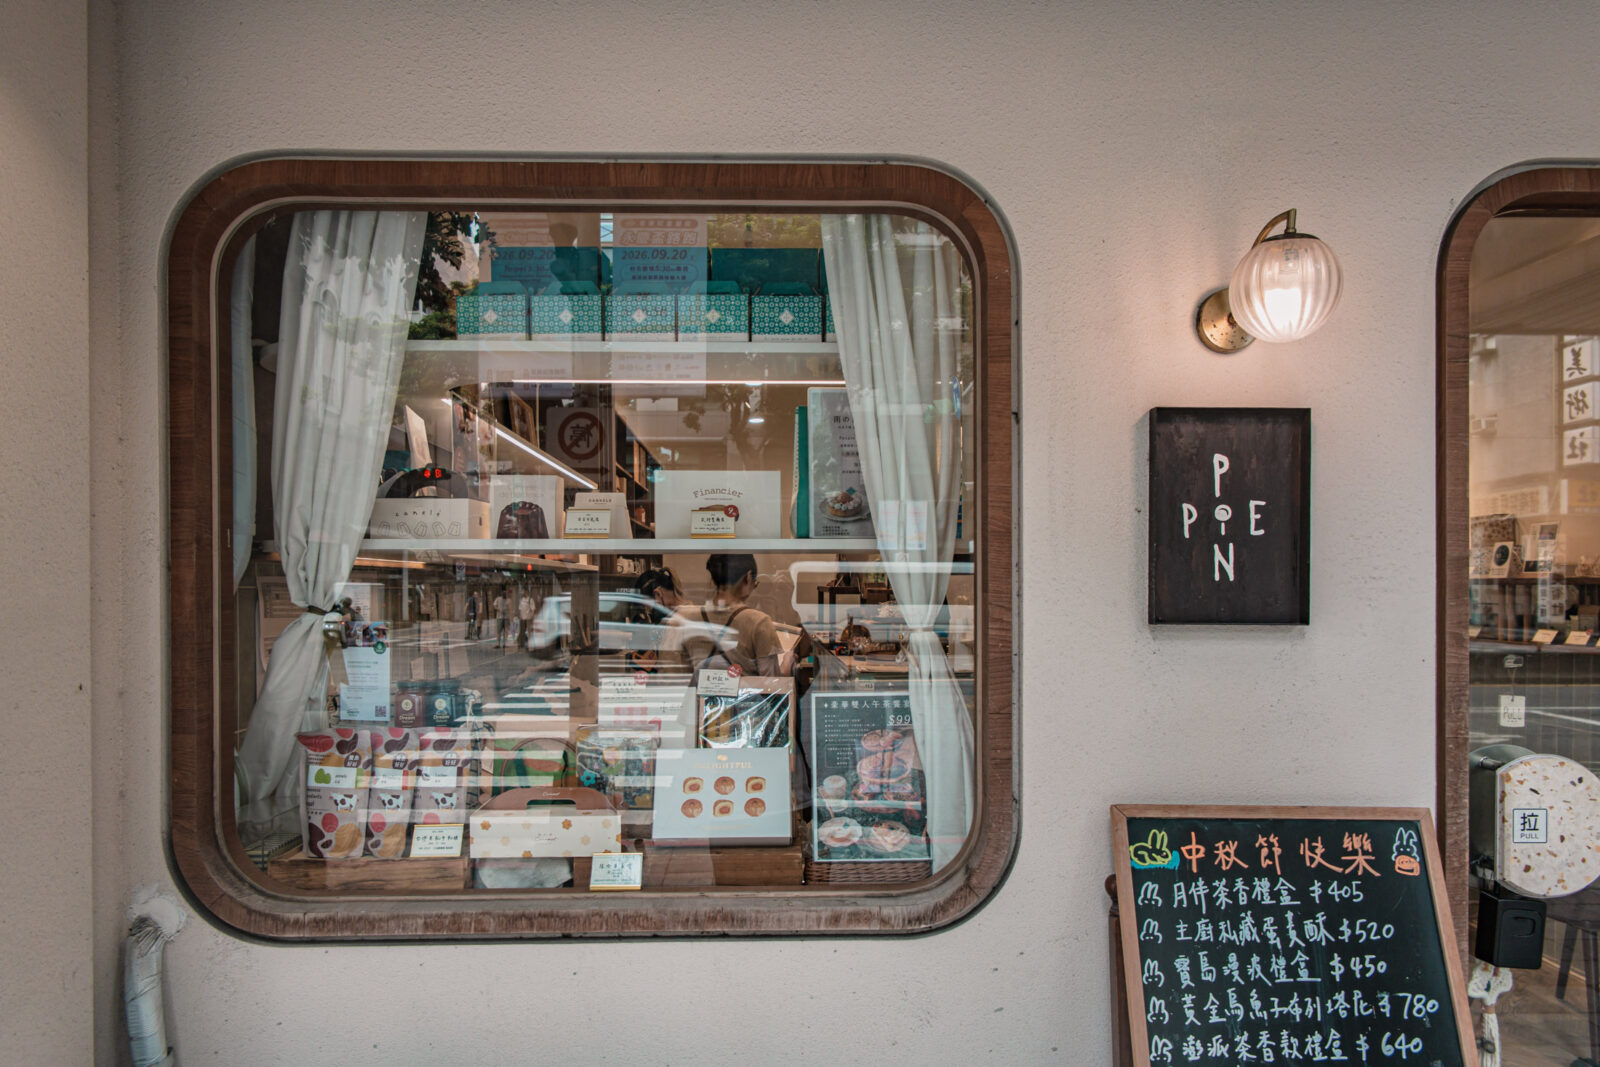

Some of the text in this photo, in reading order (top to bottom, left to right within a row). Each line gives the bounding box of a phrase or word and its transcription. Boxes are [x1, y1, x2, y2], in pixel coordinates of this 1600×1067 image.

[692, 487, 744, 498] Financier
[888, 714, 912, 725] $99
[1520, 812, 1540, 832] 拉
[1519, 832, 1540, 840] PULL
[1180, 831, 1382, 876] 中秋節快樂
[1173, 876, 1365, 914] 月伴茶香禮盒 $405
[1338, 917, 1394, 944] $520
[1173, 950, 1388, 989] 寶島漫波禮盒 $450
[1356, 1031, 1423, 1061] $640
